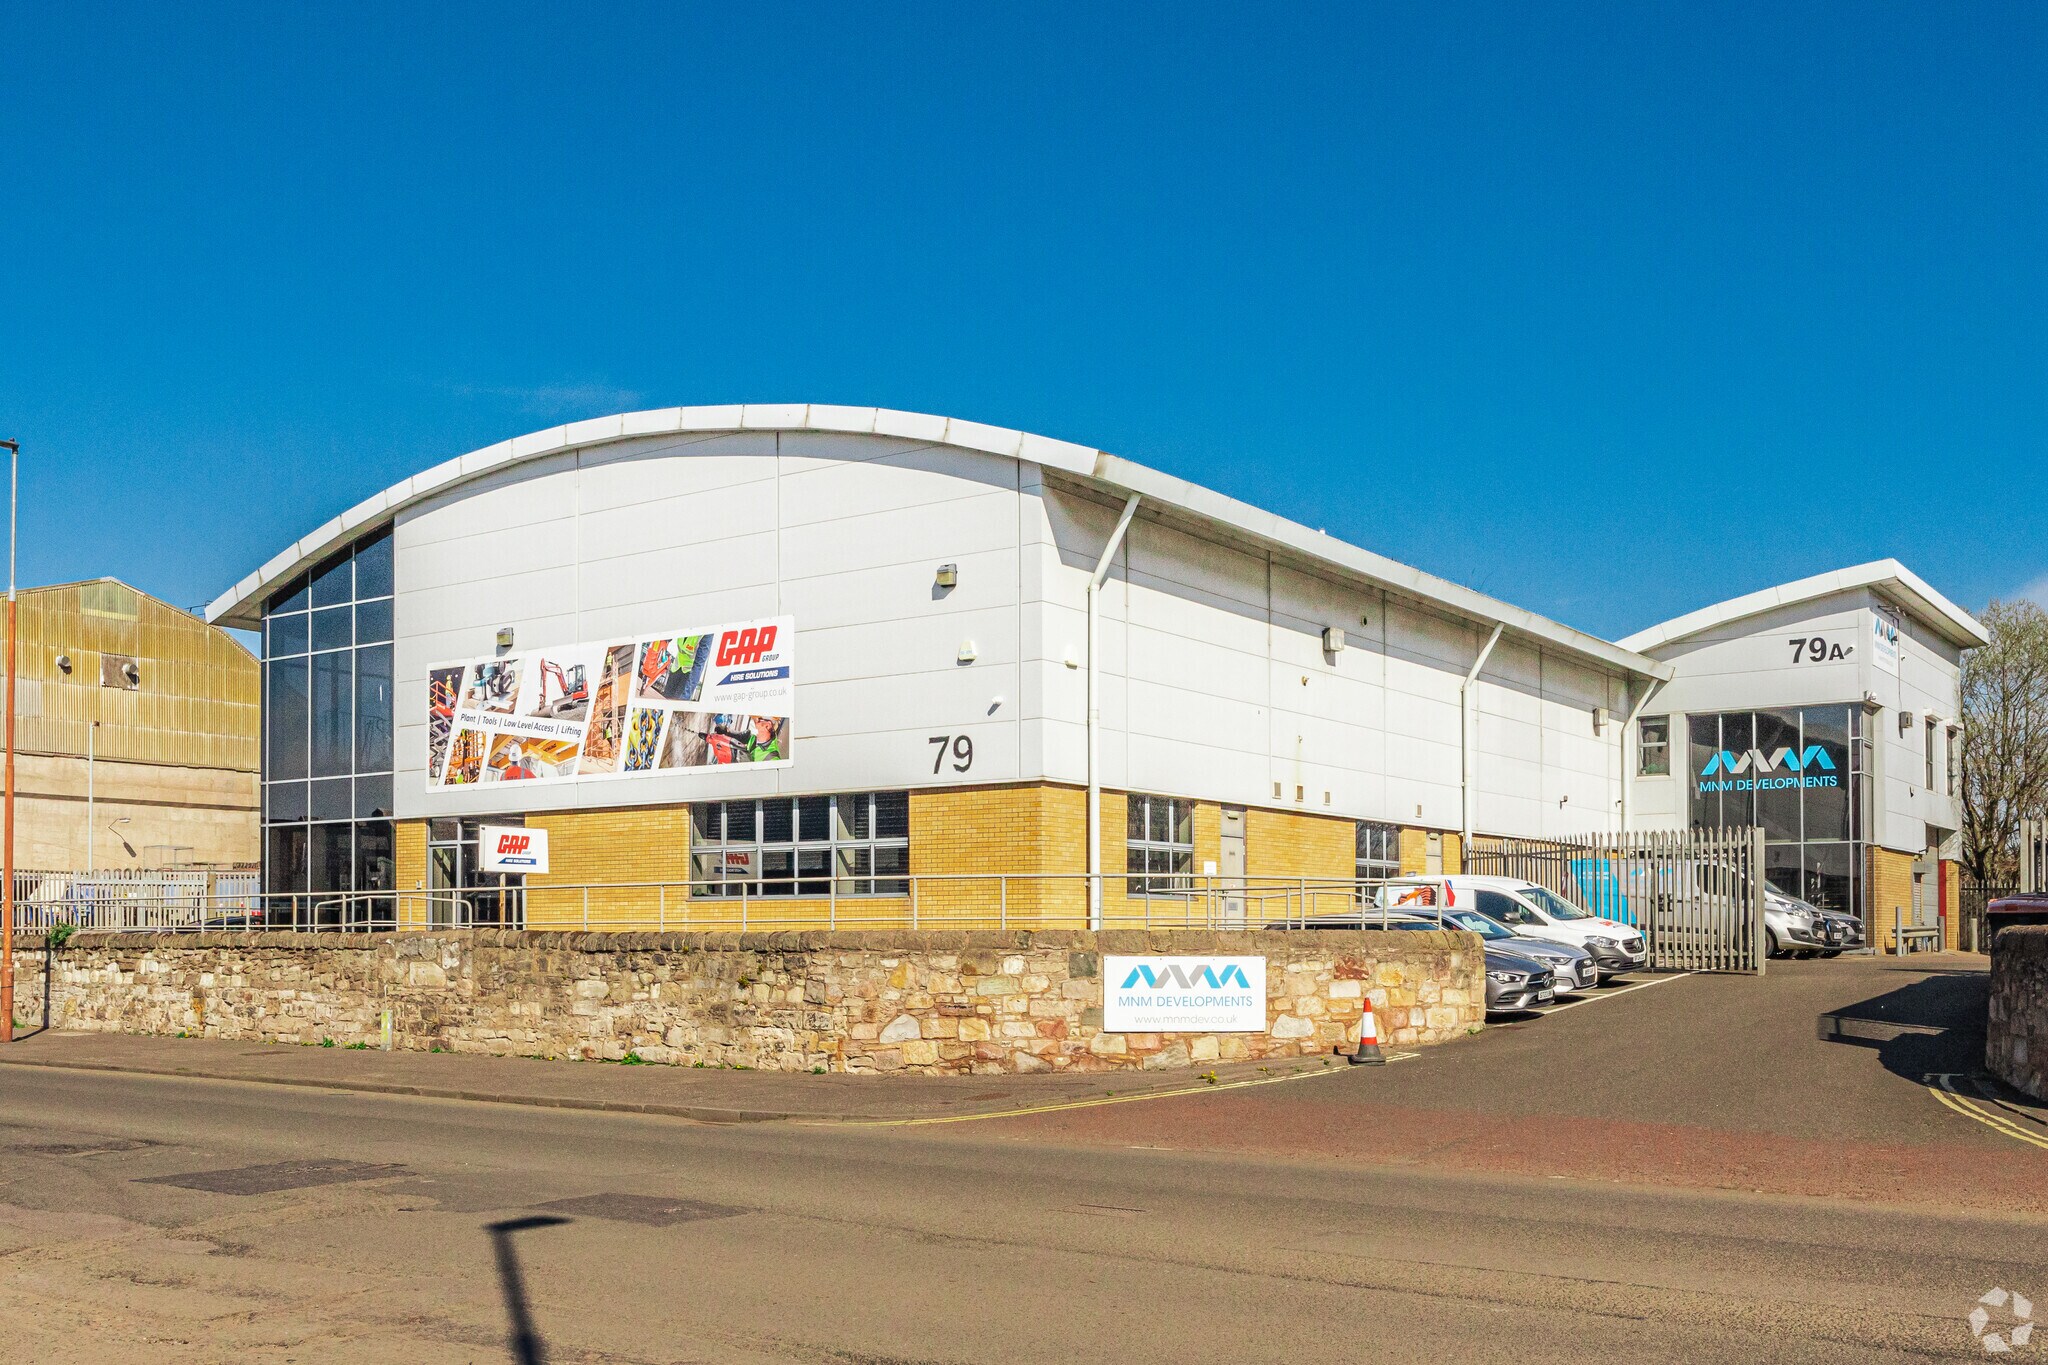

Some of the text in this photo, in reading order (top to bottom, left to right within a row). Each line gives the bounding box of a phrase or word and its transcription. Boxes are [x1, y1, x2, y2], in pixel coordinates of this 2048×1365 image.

[716, 626, 778, 667] GAP
[762, 654, 779, 662] GROUP
[730, 670, 778, 681] HIRE SOLUTIONS
[714, 687, 787, 702] www.gap-group.co.uk
[460, 713, 582, 738] Plant Tools Low Level Access Lifting
[929, 735, 973, 774] 79
[1700, 775, 1838, 792] MNM DEVELOPMENTS
[497, 834, 530, 854] GAP
[1118, 996, 1253, 1007] MNM DEVELOPMENTS
[1134, 1015, 1238, 1024] www.mnmdev.co.uk
